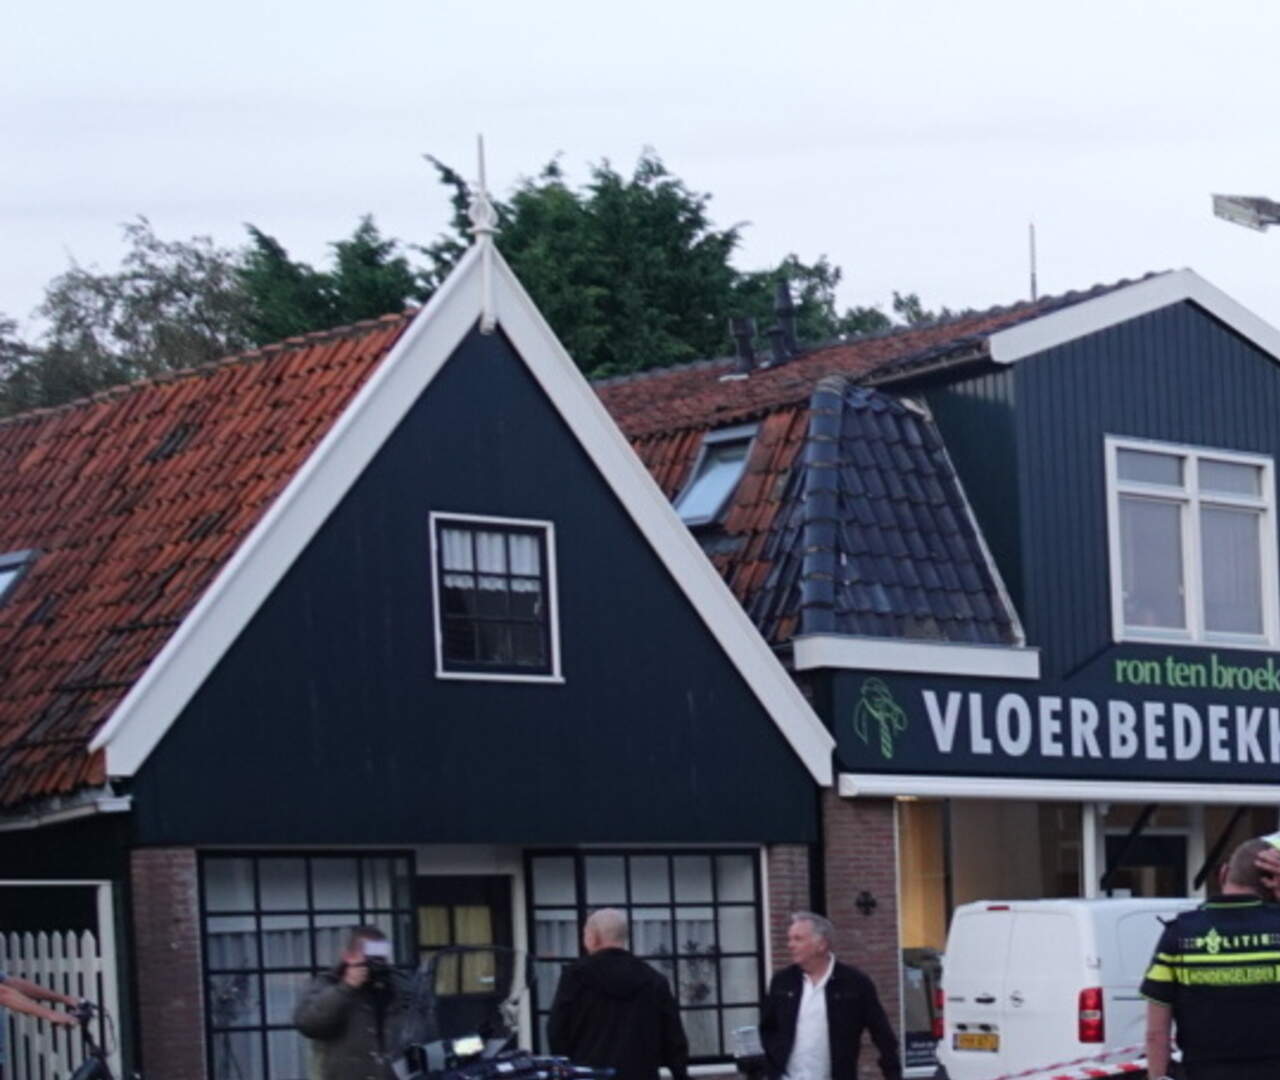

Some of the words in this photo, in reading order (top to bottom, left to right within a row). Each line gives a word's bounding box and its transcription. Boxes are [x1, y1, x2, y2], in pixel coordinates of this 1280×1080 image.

[1115, 659, 1161, 685] ron
[1166, 656, 1206, 687] ten
[1195, 933, 1269, 954] POLITIE
